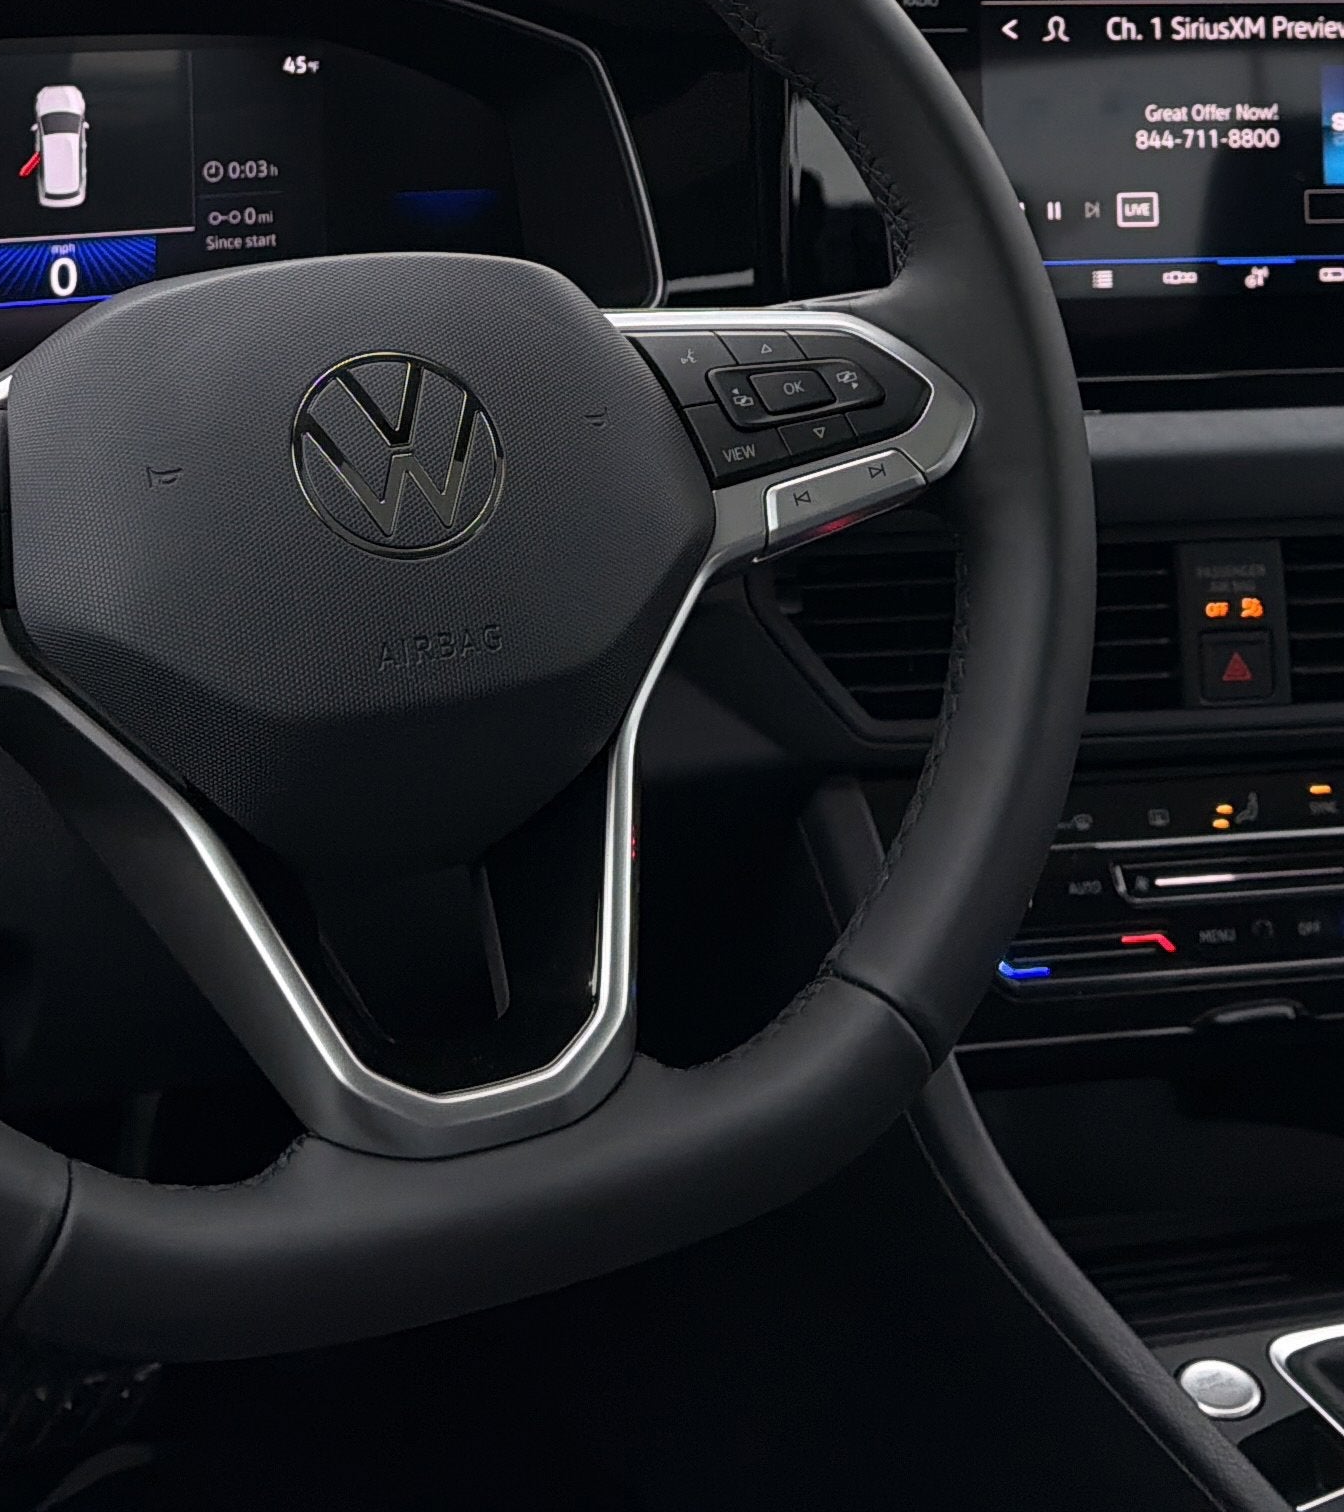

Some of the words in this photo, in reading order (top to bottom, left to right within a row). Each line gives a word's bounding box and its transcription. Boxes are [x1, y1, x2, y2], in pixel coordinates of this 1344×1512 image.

[1106, 15, 1144, 41] Ch.
[1150, 16, 1163, 40] 1
[1170, 15, 1266, 41] SiriusXM
[1144, 103, 1188, 123] Great
[1191, 103, 1233, 122] Offer
[1235, 103, 1280, 121] Now!
[1134, 127, 1281, 150] 844-711-8800
[1123, 203, 1151, 217] LIVE
[205, 235, 242, 251] Since
[245, 233, 277, 248] start
[49, 256, 78, 296] 0
[782, 380, 805, 395] OK
[722, 443, 756, 463] VIEW
[378, 624, 504, 672] AIRBAG
